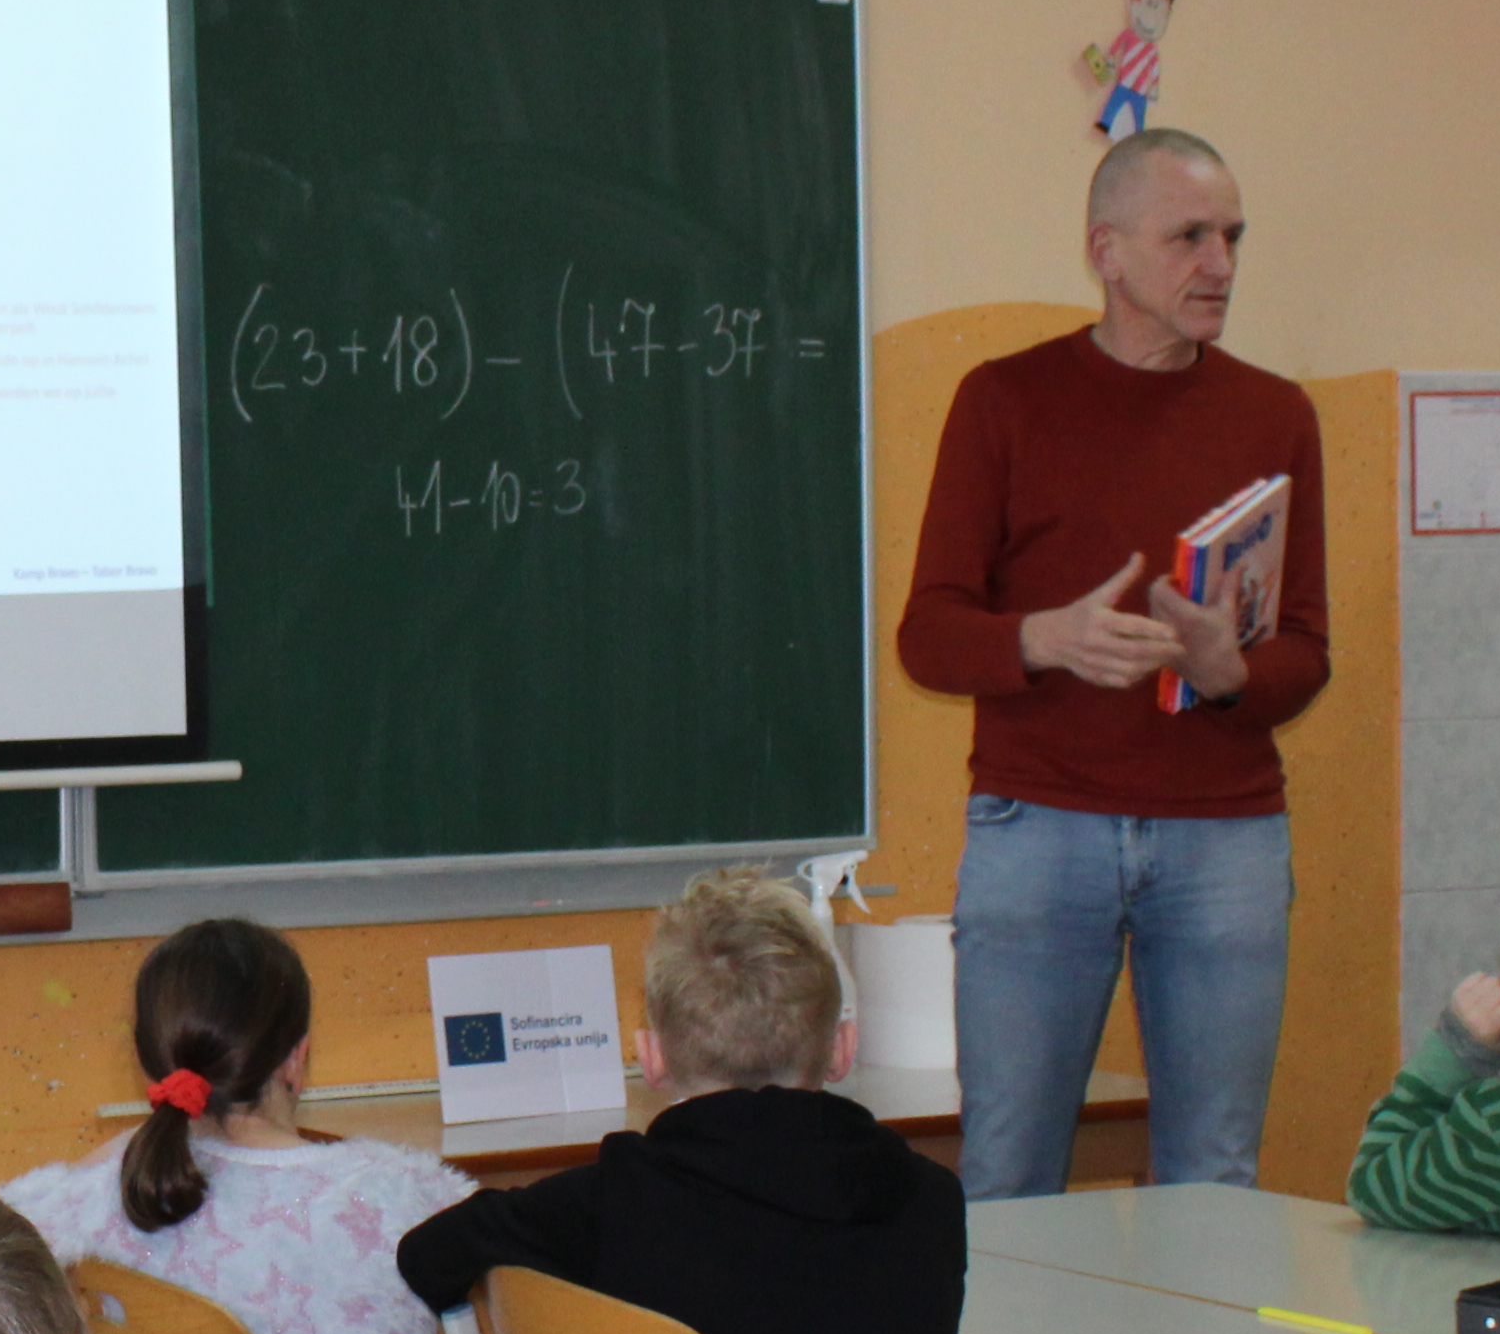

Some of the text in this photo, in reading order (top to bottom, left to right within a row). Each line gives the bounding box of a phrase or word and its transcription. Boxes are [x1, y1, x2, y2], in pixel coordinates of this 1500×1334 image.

[510, 1013, 583, 1031] Sofinancira
[512, 1031, 609, 1052] Evropska unija
